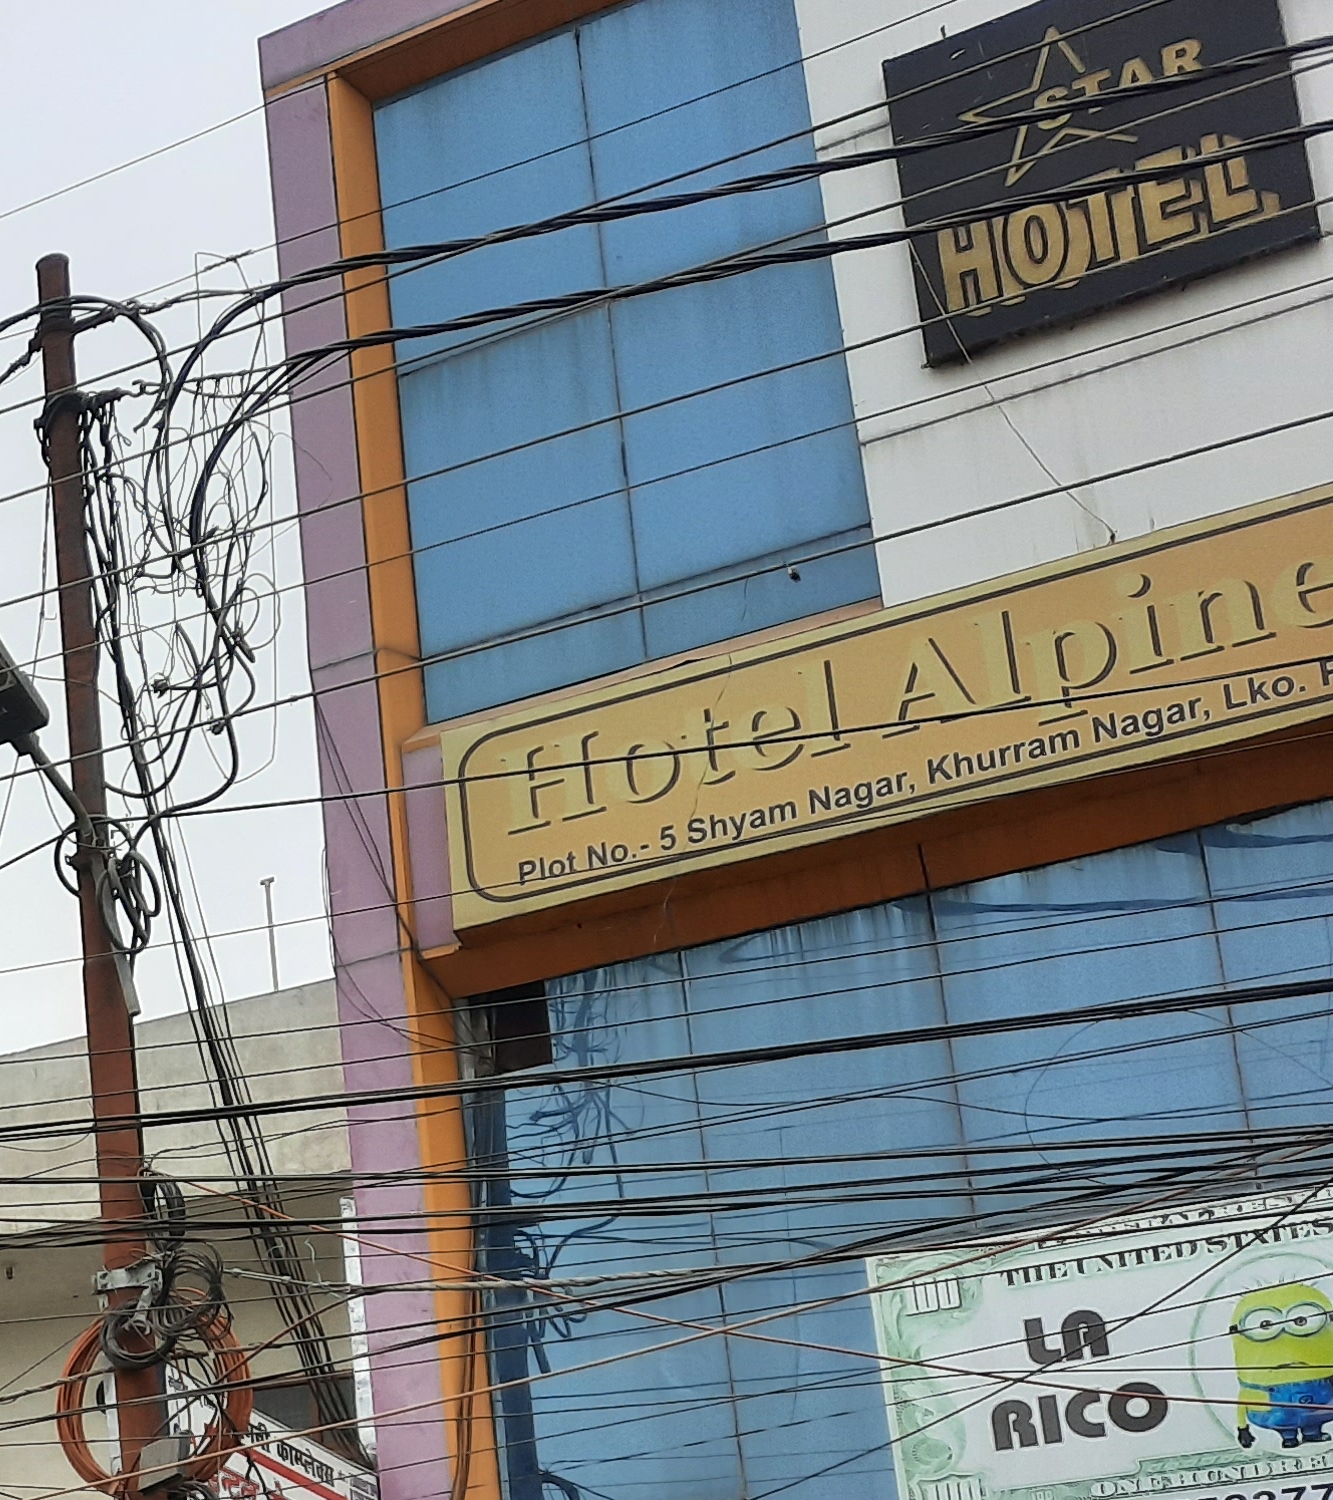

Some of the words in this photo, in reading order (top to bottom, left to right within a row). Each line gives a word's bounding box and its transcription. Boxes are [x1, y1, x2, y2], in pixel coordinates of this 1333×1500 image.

[1034, 38, 1204, 131] STAR
[937, 133, 1279, 316] HOTEL
[502, 658, 851, 837] Hotel
[518, 847, 577, 888] Plot
[659, 821, 678, 853] 5
[687, 797, 799, 847] Shyam
[808, 767, 918, 821] Nagar,
[928, 726, 1082, 790] Khurram
[1091, 697, 1211, 743] Nagar,
[1223, 672, 1307, 711] Lko.
[1076, 1240, 1199, 1276] UNITED
[1023, 1310, 1111, 1366] LA
[991, 1381, 1169, 1452] RICO
